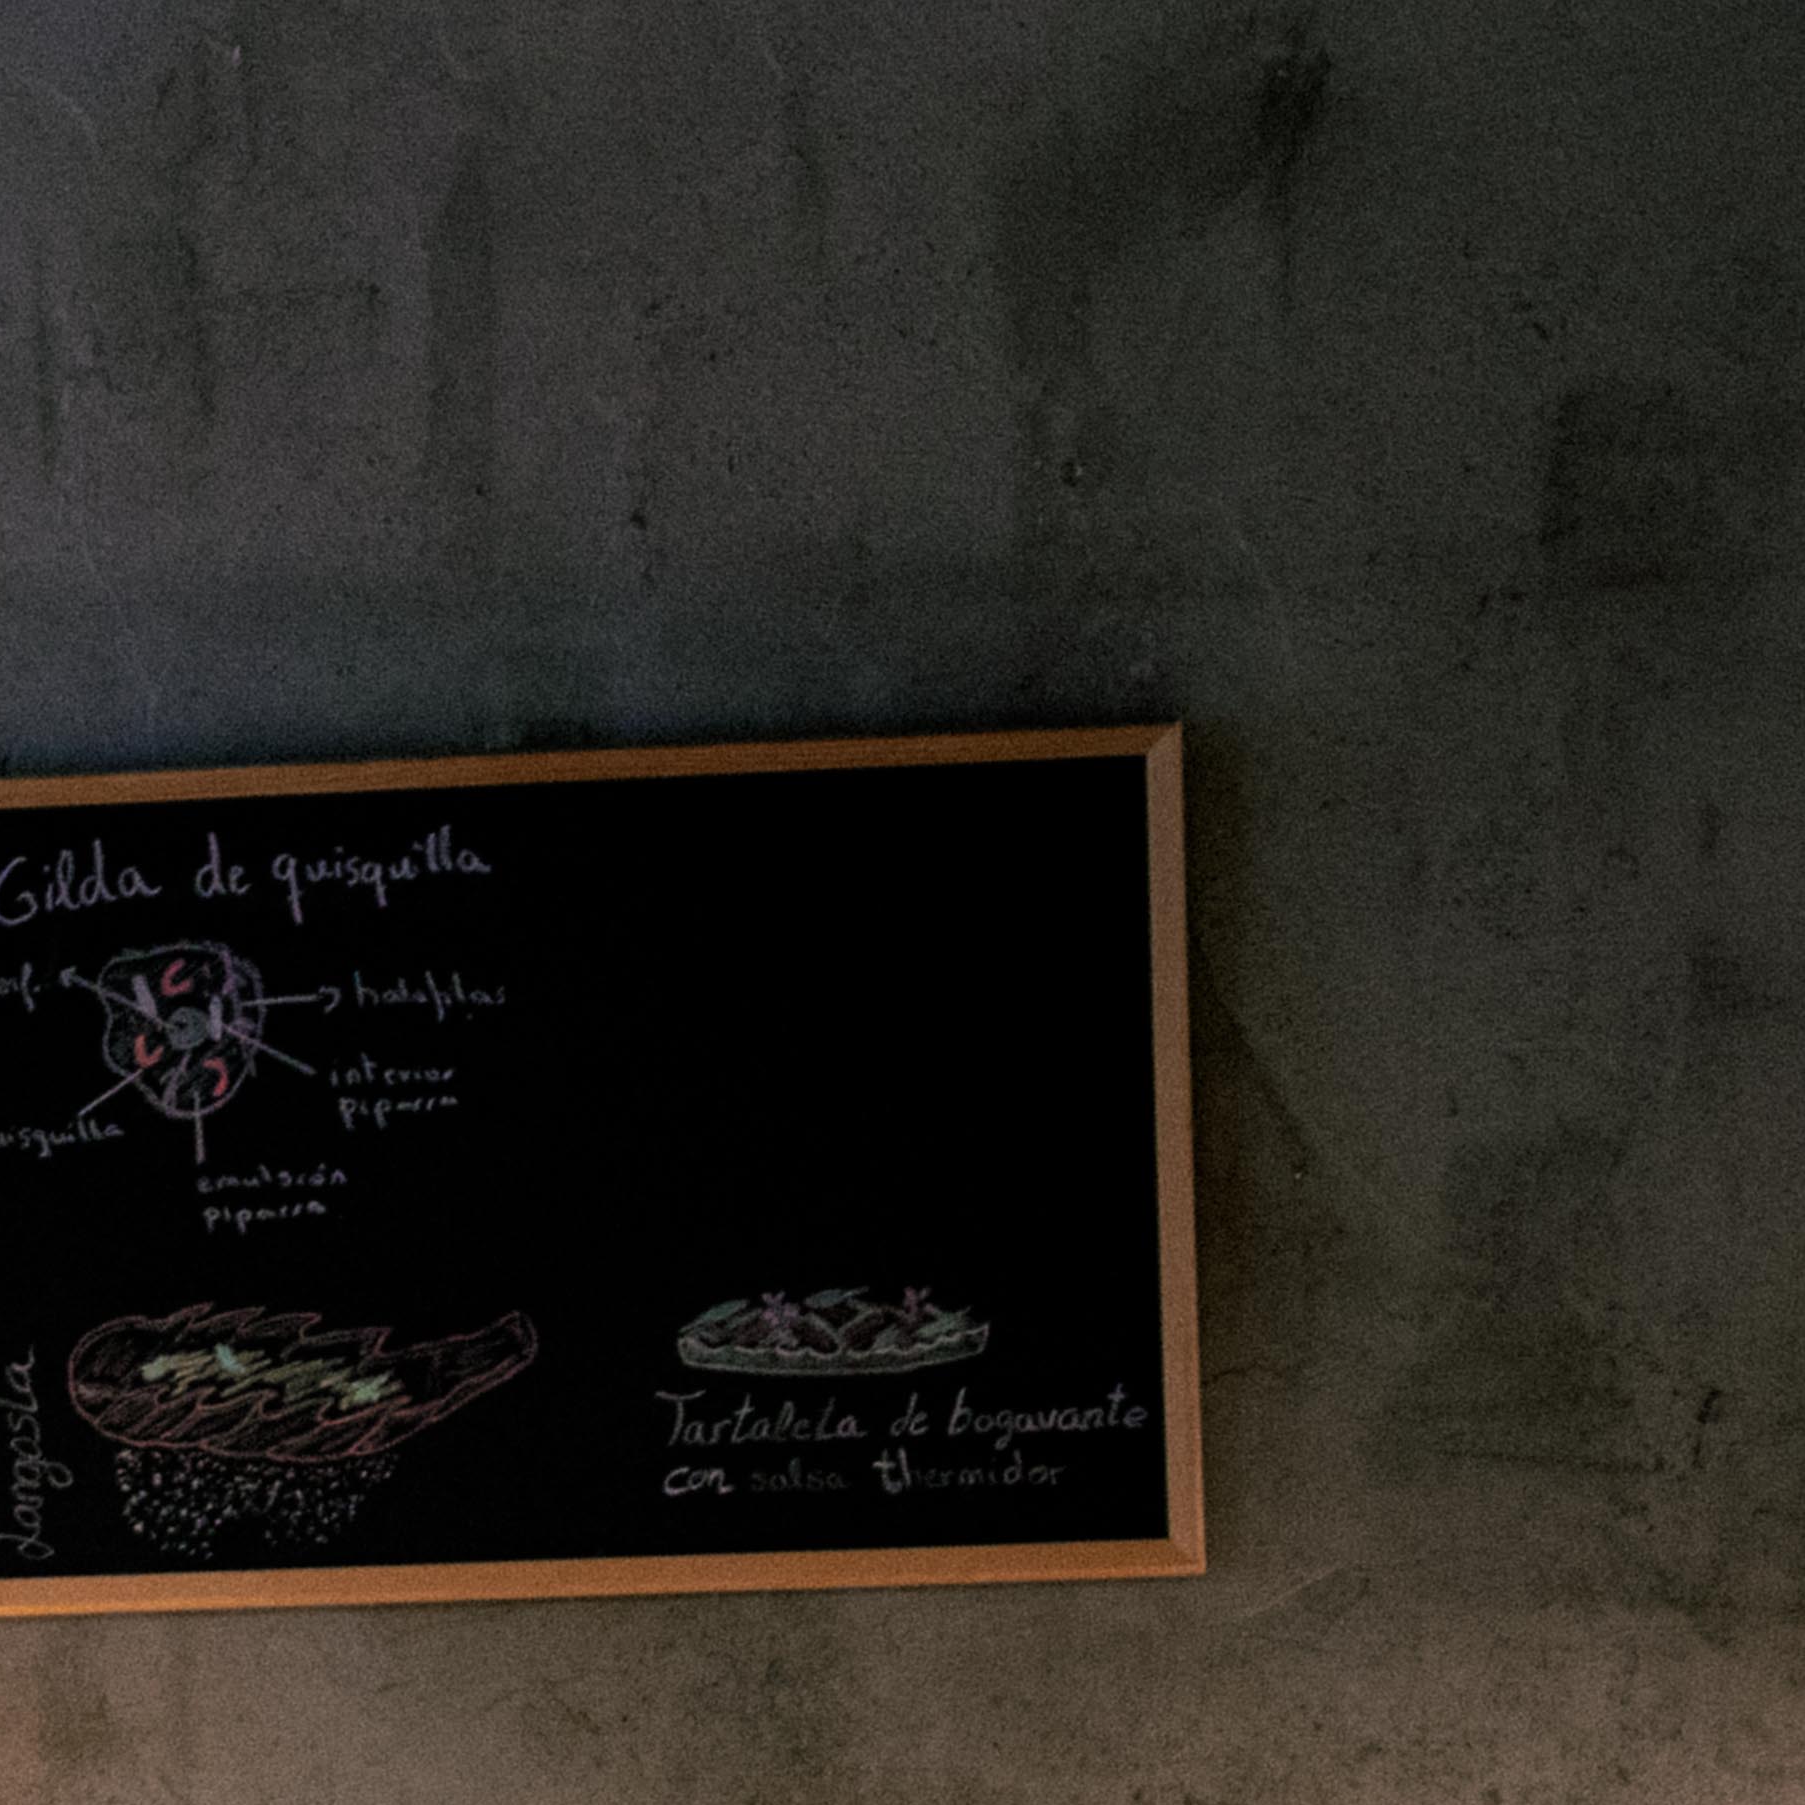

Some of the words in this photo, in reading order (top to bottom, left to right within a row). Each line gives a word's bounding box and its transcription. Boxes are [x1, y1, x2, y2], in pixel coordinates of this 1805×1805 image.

[193, 831, 252, 899] de
[271, 822, 492, 926] quisquilla
[329, 1052, 457, 1088] interior
[654, 1389, 870, 1447] Tartaleta
[890, 1391, 931, 1439] de
[945, 1381, 1150, 1451] bogavante
[661, 1464, 737, 1496] con
[748, 1456, 850, 1493] salsa
[871, 1446, 1068, 1496] thermidor
